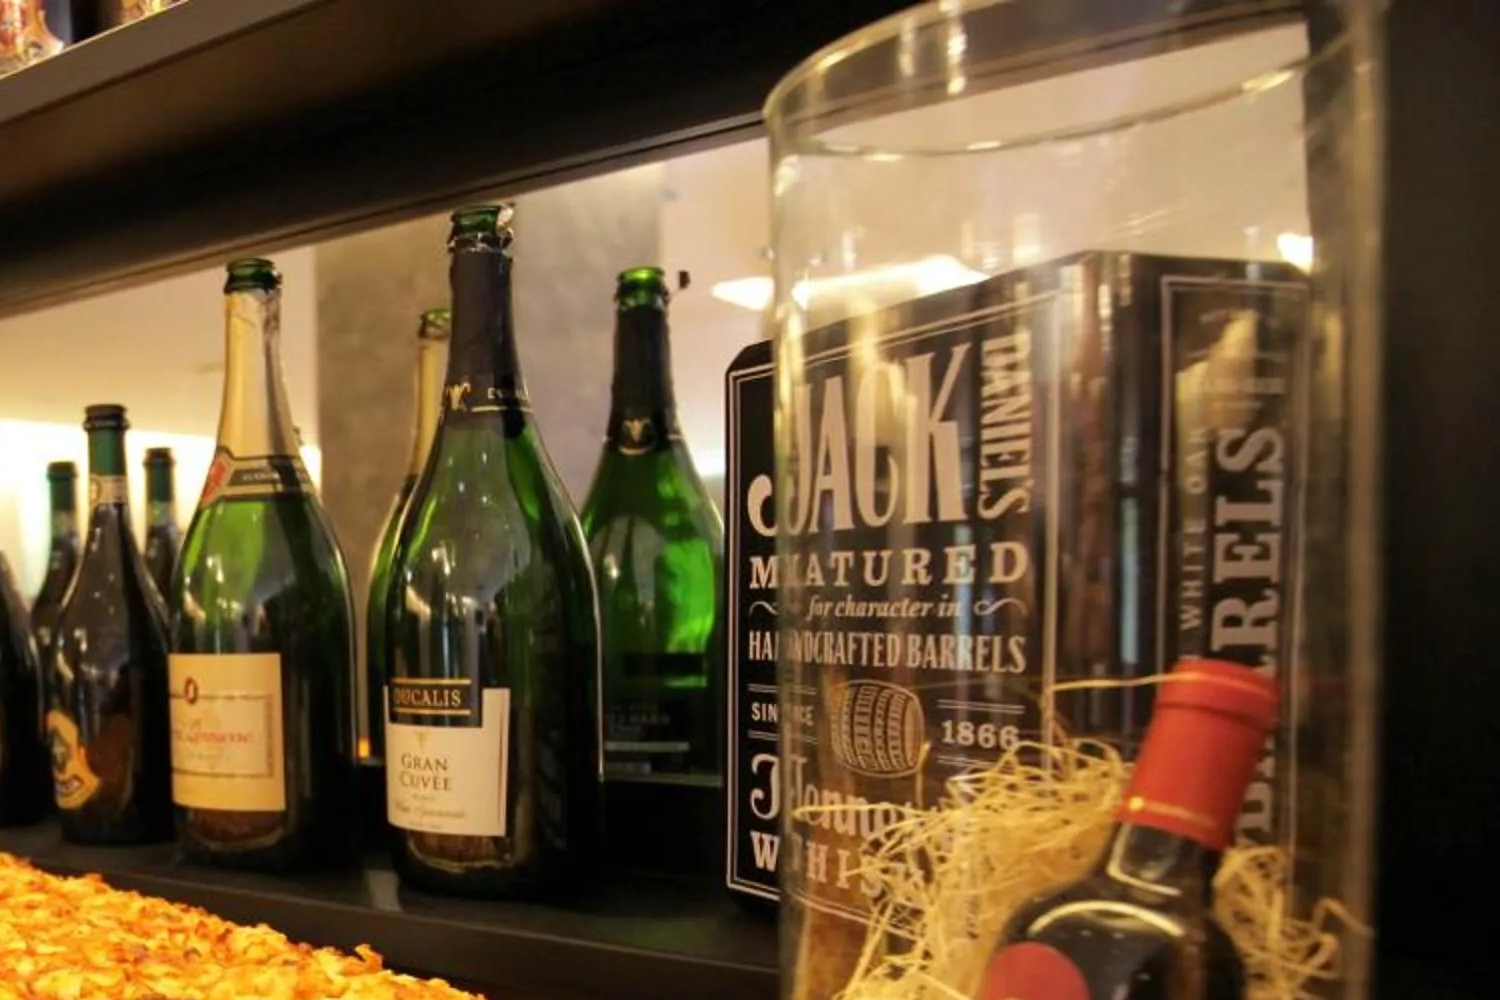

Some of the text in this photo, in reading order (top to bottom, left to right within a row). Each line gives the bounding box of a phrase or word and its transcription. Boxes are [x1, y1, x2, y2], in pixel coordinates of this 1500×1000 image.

[748, 342, 972, 537] JACK
[749, 541, 1030, 589] MATURED
[1180, 519, 1205, 631] WHITE
[806, 593, 963, 622] for character in
[748, 630, 1027, 673] HANDCRAFTED BARRELS
[941, 719, 1020, 751] 1866
[401, 753, 448, 771] GRAN
